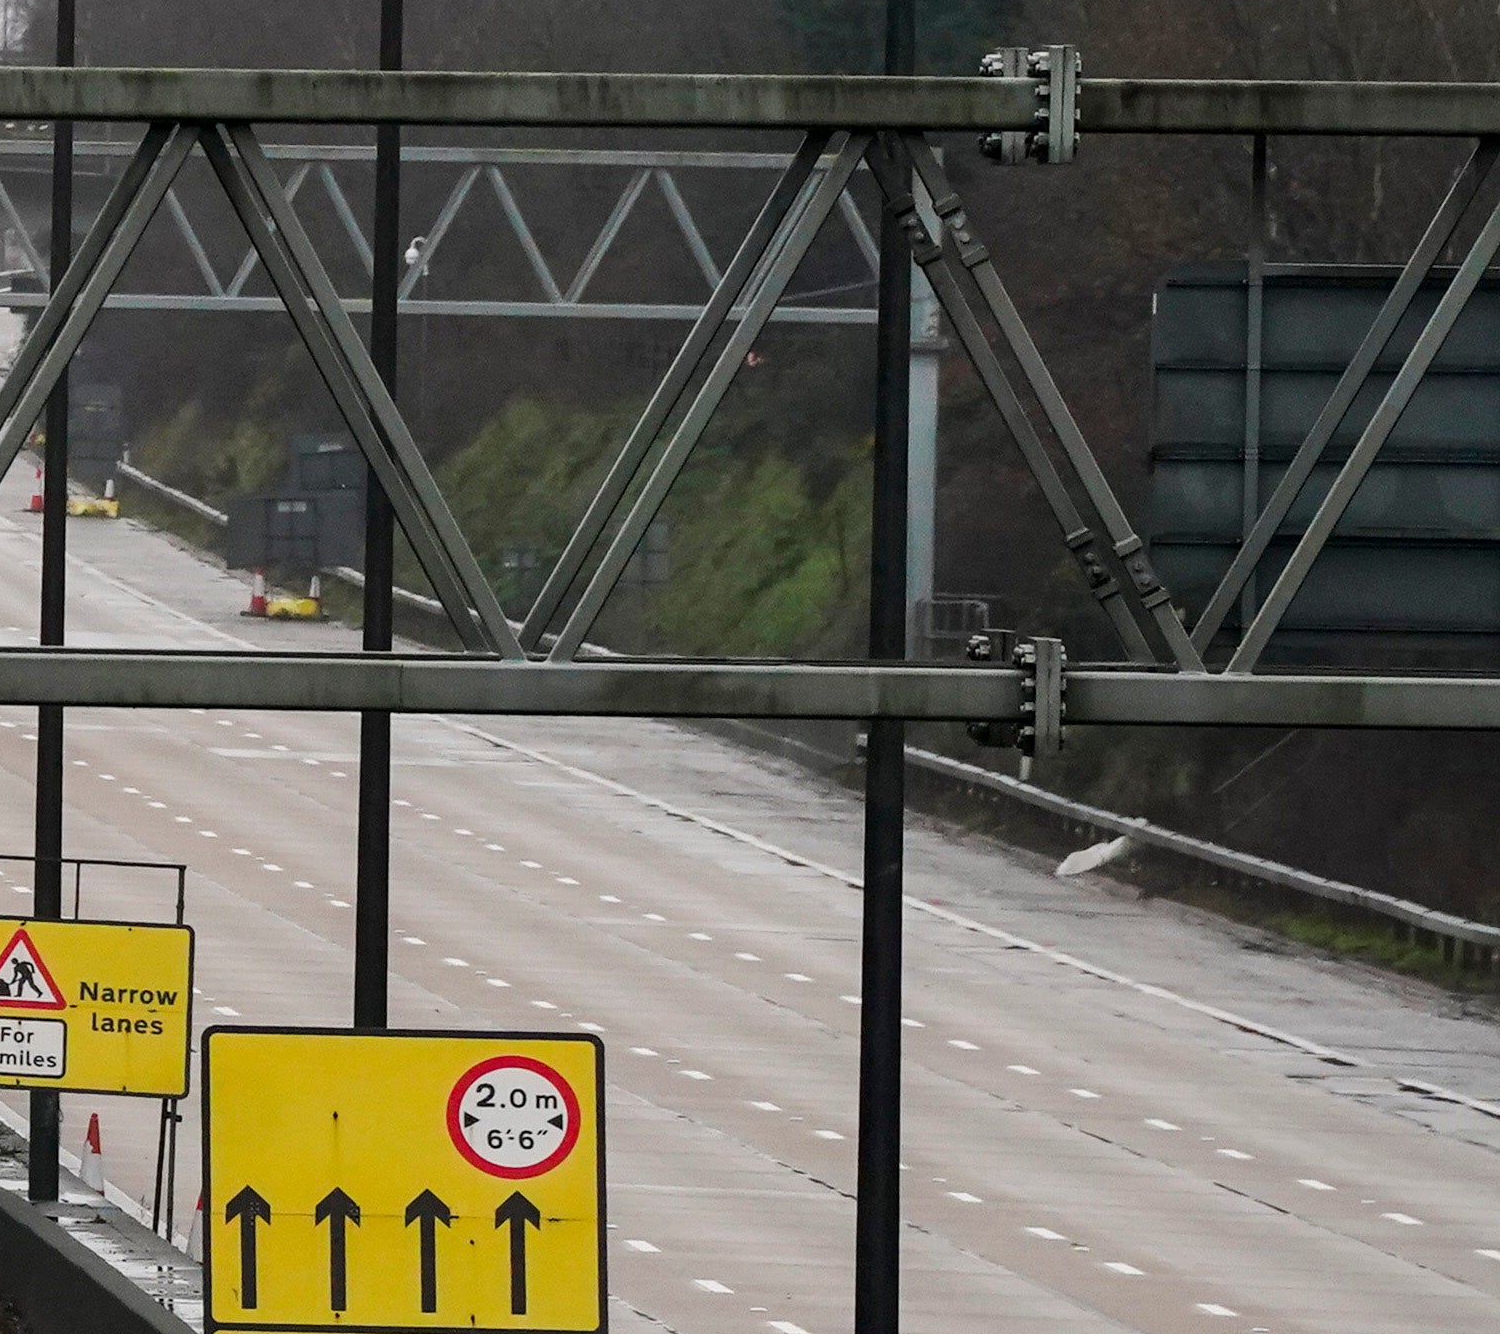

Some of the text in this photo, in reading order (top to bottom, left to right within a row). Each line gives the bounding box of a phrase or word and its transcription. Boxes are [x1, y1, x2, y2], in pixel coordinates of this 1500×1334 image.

[78, 980, 179, 1007] Narrow
[91, 1011, 164, 1035] lanes
[0, 1026, 35, 1045] For
[0, 1047, 58, 1069] miles
